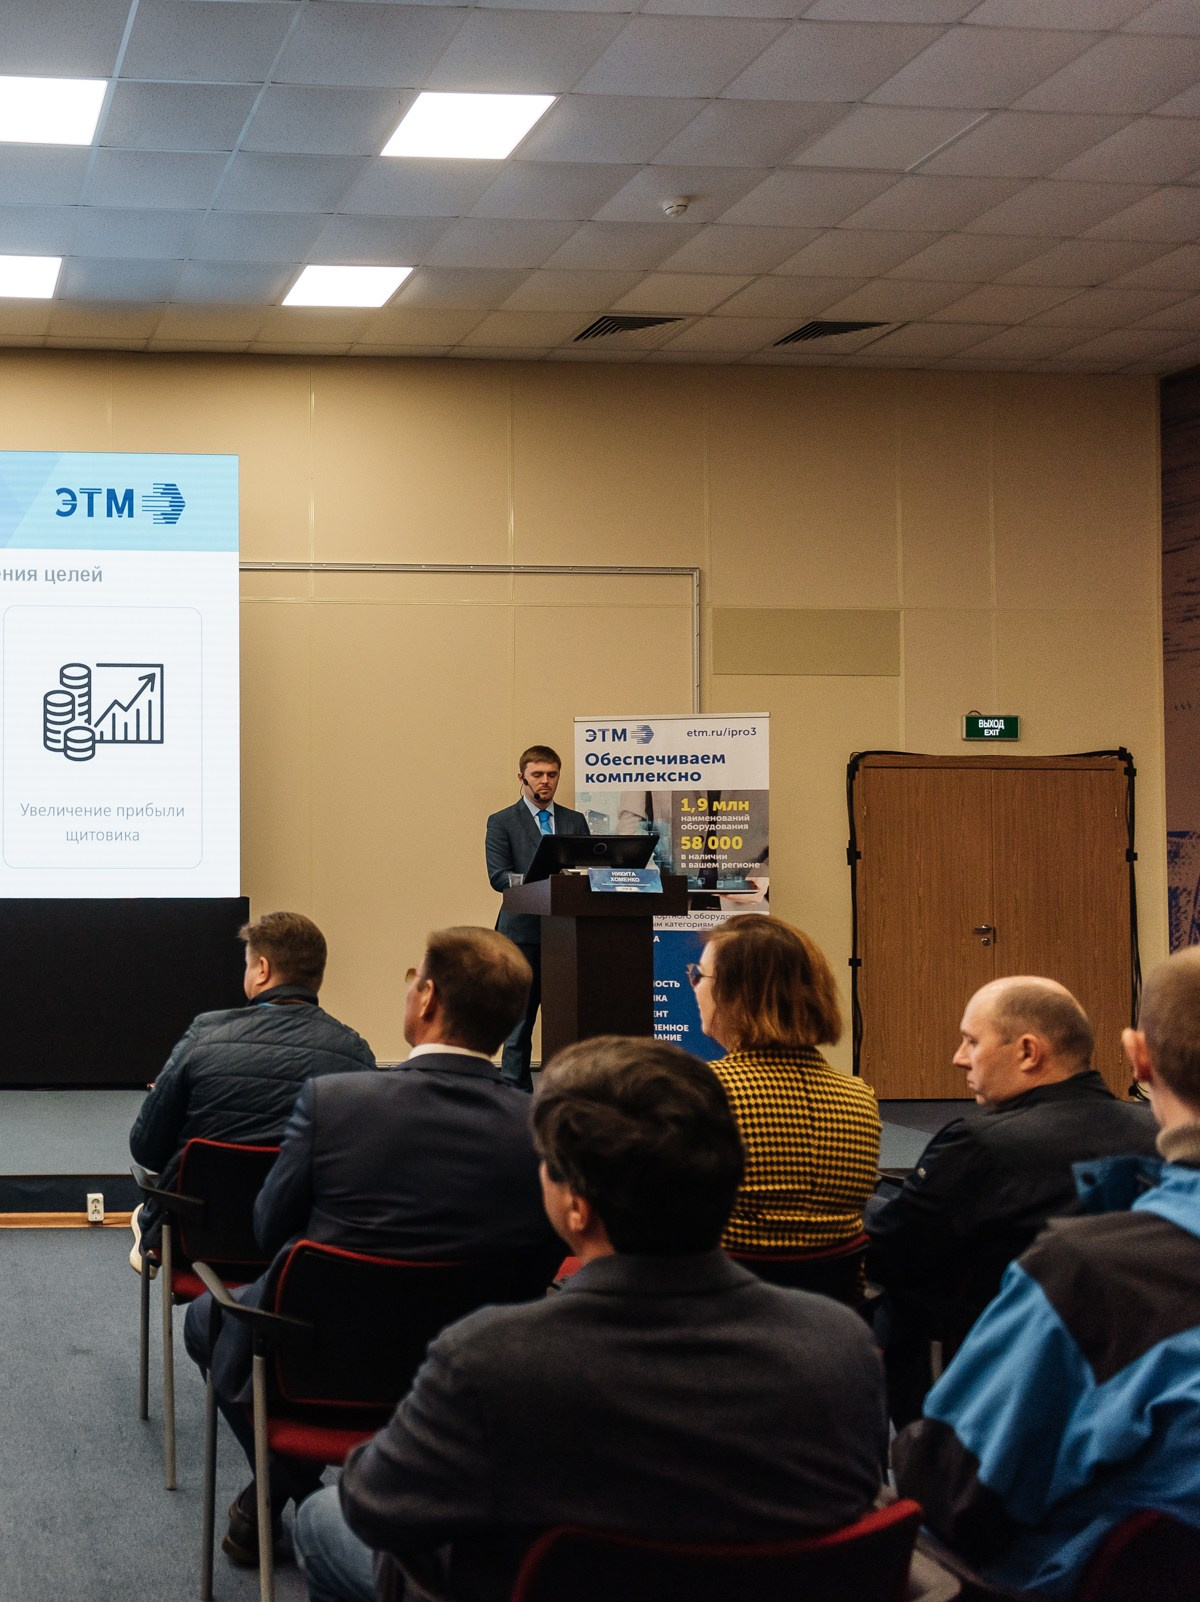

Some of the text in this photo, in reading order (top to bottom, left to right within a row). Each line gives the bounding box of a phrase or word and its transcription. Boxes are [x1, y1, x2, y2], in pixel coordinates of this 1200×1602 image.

[55, 487, 134, 518] ЭТМ
[44, 566, 102, 584] целей
[978, 719, 1004, 729] ВЫХОД
[585, 728, 627, 742] ЭТМ
[686, 727, 757, 738] etm.ru/ipro3
[585, 752, 726, 766] Обеспечиваем
[585, 770, 702, 783] комплексно
[20, 802, 185, 820] Увеличение прибыли
[680, 798, 750, 814] 1,9 млн
[680, 814, 750, 822] наименований
[680, 823, 749, 831] оборудования
[66, 829, 140, 844] щитовика
[680, 836, 743, 850] 58 000
[722, 862, 760, 870] регионе
